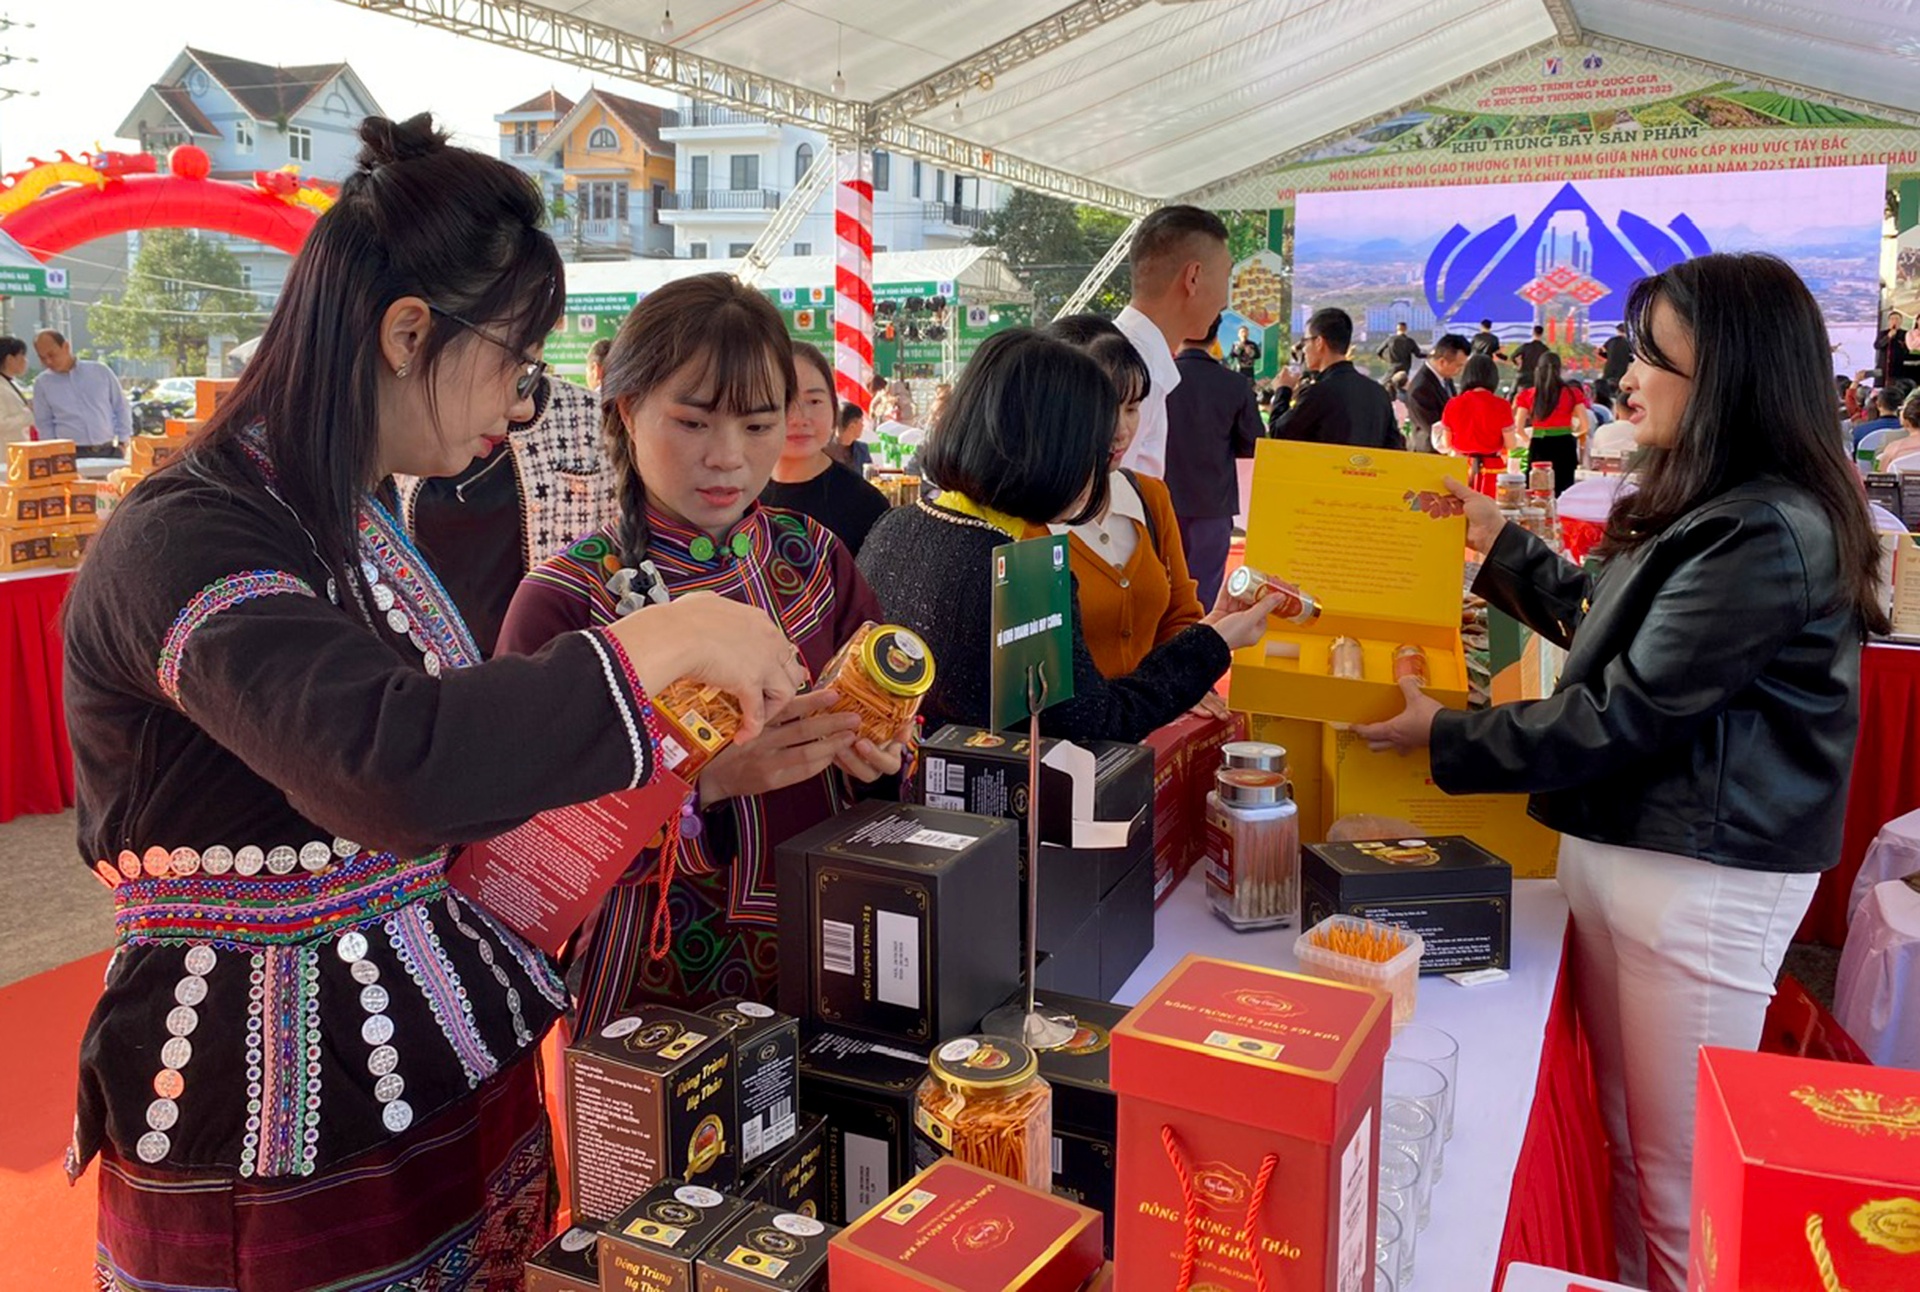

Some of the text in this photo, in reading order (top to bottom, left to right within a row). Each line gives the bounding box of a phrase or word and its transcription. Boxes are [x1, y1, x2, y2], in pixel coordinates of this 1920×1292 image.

[1637, 74, 1658, 84] GIA
[1429, 162, 1457, 174] GIAO
[1564, 154, 1592, 167] NAM
[1662, 146, 1698, 160] CUNG
[1730, 142, 1758, 155] KHU
[1451, 139, 1488, 154] KHU
[1492, 134, 1553, 152] TRƯNG
[1138, 1201, 1180, 1223] ĐÔNG
[1260, 1237, 1301, 1260] THẢO
[614, 1256, 673, 1285] Đông Trùng
